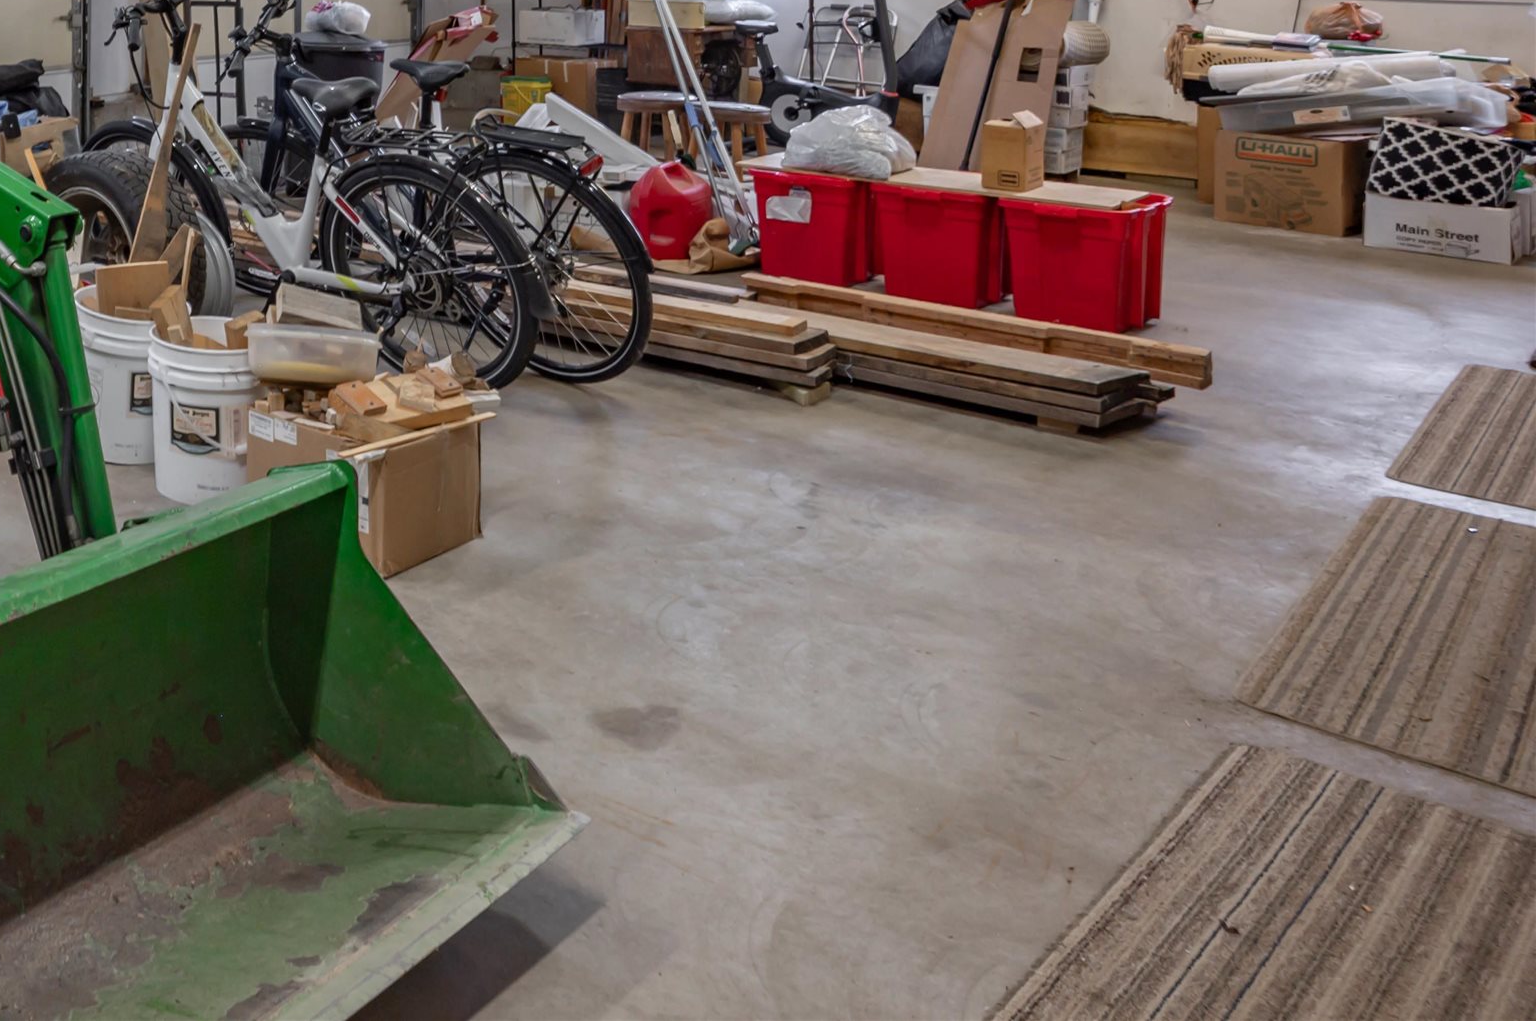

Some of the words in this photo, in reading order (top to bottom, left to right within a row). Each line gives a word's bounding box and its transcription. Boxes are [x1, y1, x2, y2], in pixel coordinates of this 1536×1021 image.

[1240, 140, 1313, 158] U-HAUL
[1395, 222, 1430, 237] Main
[1435, 228, 1480, 243] Street
